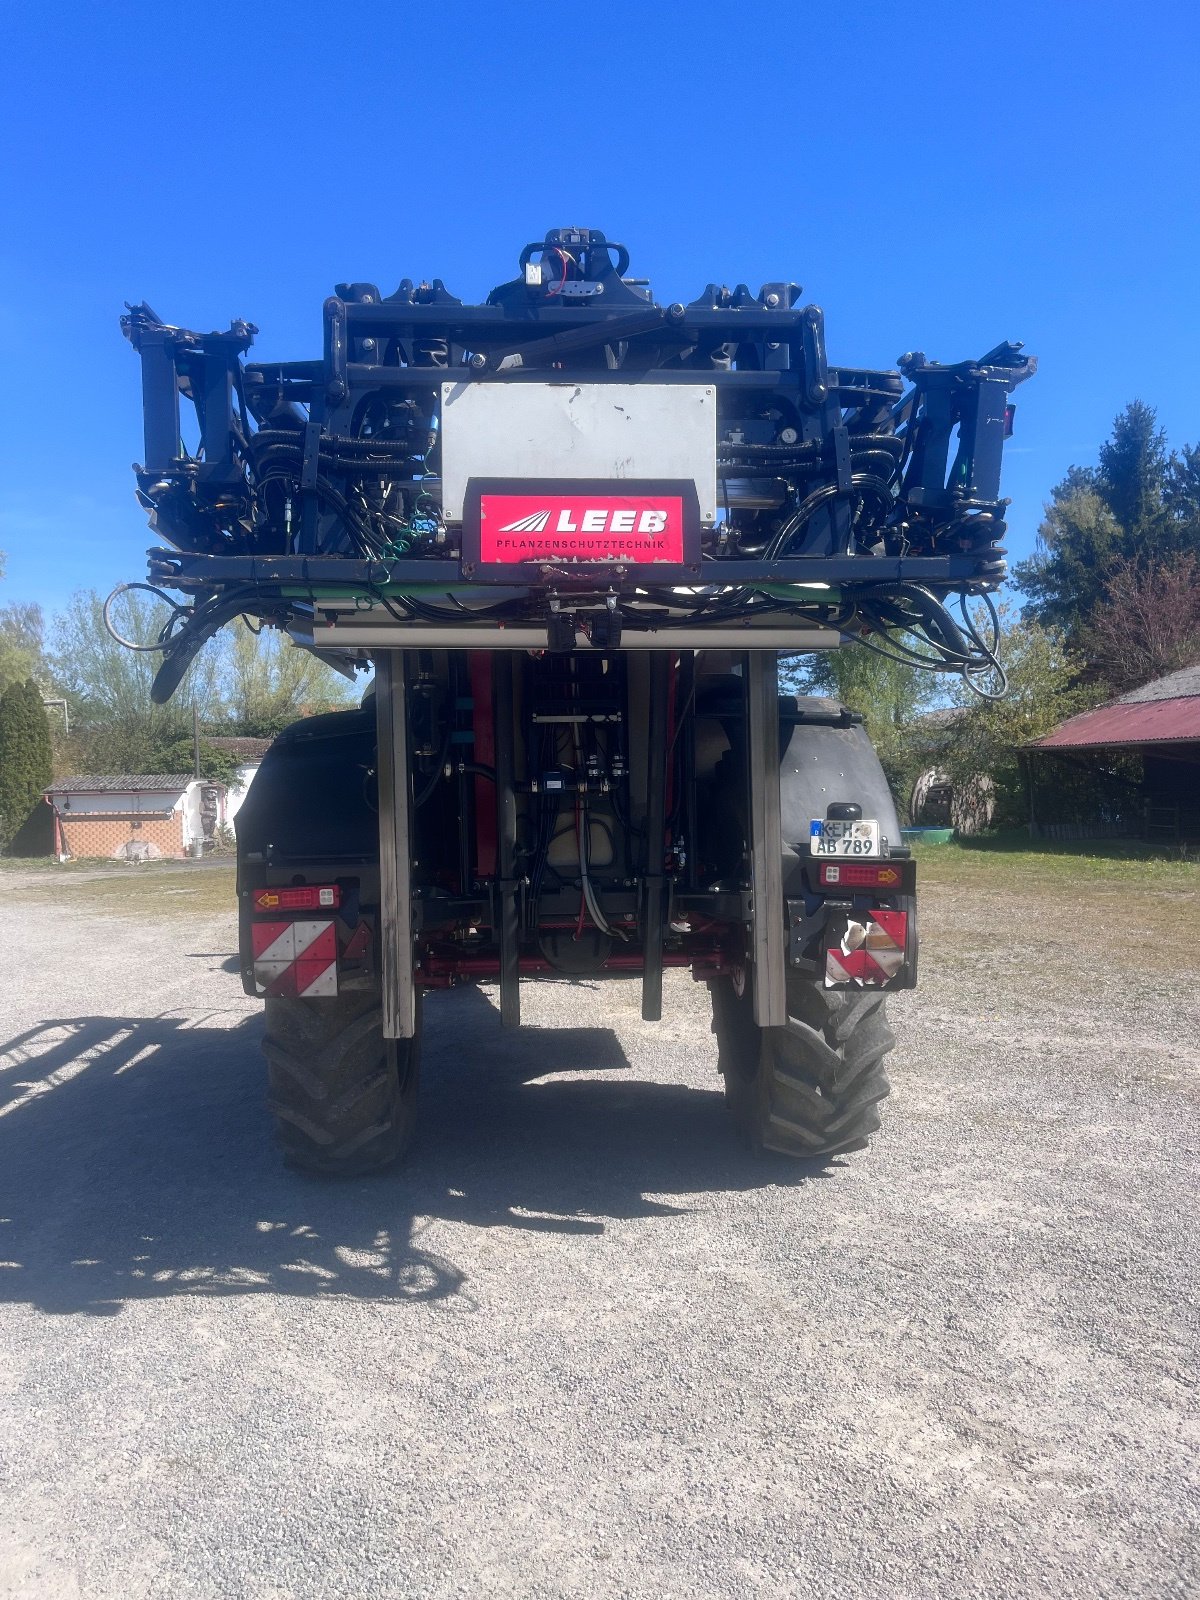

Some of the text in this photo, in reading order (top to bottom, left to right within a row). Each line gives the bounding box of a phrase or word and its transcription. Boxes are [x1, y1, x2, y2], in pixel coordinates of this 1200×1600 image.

[556, 509, 668, 533] LEEB
[496, 540, 665, 549] PFLANZENSCHUTZTECHNIK
[821, 822, 852, 837] KEH
[816, 839, 873, 854] AB 789
